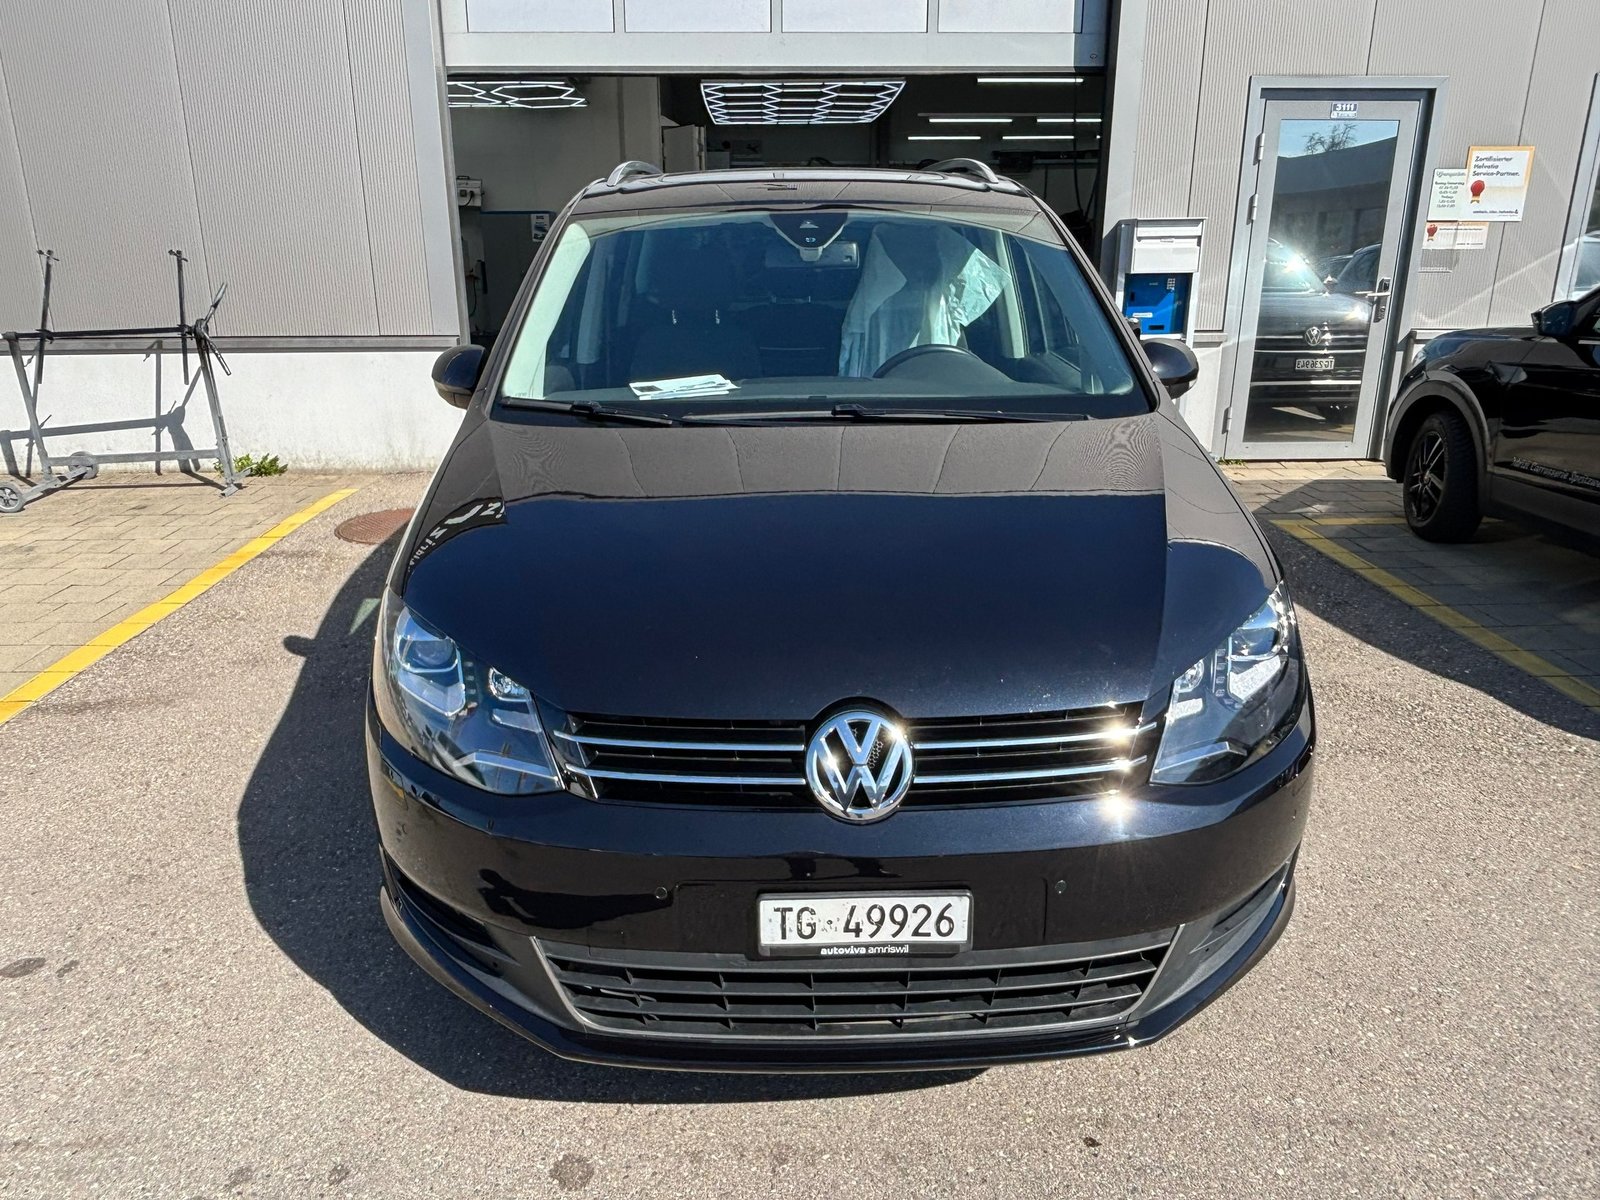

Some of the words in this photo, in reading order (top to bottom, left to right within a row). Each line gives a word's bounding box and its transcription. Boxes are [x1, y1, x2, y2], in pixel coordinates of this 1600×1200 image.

[774, 906, 817, 940] TG
[843, 902, 955, 939] 49926
[820, 945, 866, 955] autoviva
[867, 944, 909, 955] amriswil
